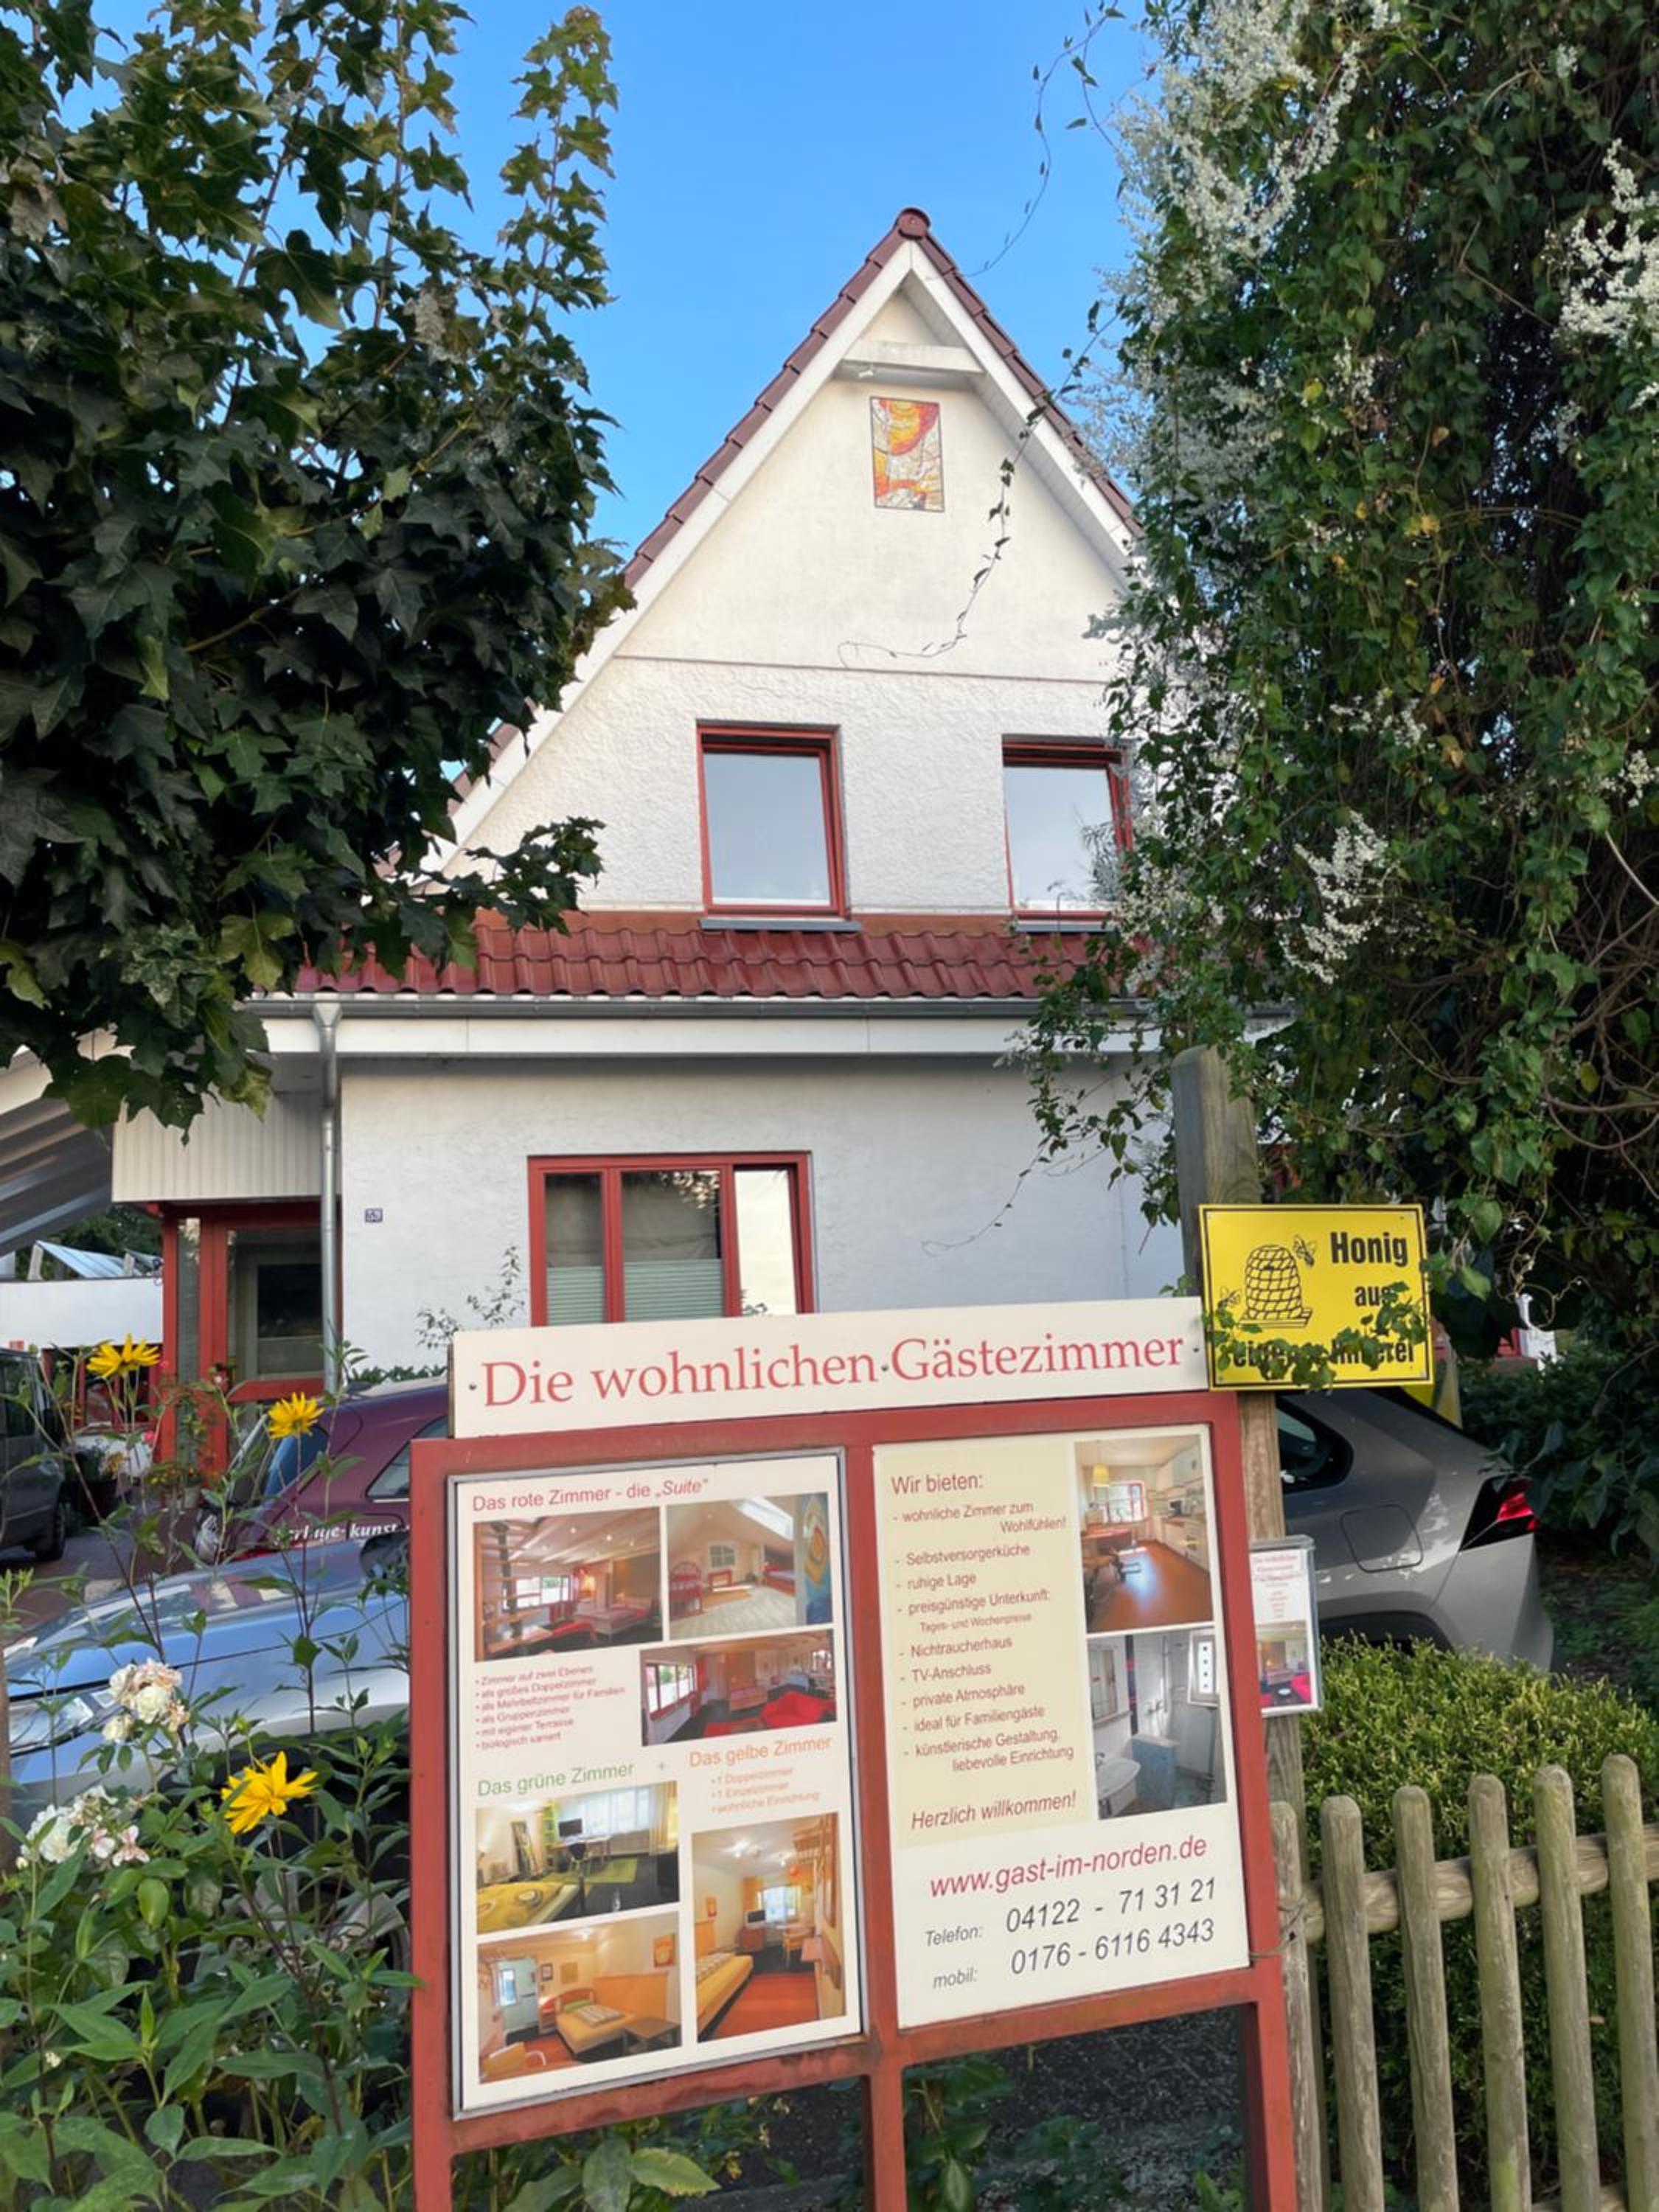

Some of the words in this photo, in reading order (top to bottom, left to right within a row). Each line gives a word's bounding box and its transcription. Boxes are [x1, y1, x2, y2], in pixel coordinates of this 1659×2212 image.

[1330, 1231, 1408, 1267] Honig
[481, 1360, 574, 1408] Die
[591, 1344, 877, 1400] wohnlichen
[891, 1332, 1184, 1382] Gästezimmer
[891, 1475, 921, 1495] Wir
[926, 1473, 984, 1493] bieten:
[472, 1495, 507, 1512] Das
[511, 1491, 544, 1509] rote
[548, 1486, 612, 1506] Zimmer
[626, 1481, 650, 1499] die
[902, 1508, 961, 1523] wohnliche
[964, 1503, 1006, 1519] Zimmer
[1009, 1501, 1034, 1514] zum
[999, 1515, 1067, 1534] Wohlfühlen!
[905, 1543, 1032, 1567] Selbstversorgerküche
[907, 1575, 945, 1592] ruhige
[947, 1572, 977, 1589] Lage
[908, 1597, 987, 1617] preisgünstige
[911, 1636, 1013, 1658] Nichtraucherhaus
[481, 1674, 517, 1686] Zimmer
[531, 1677, 597, 1693] Doppelzimmer
[911, 1663, 992, 1683] TV-Anschluss
[587, 1686, 626, 1699] Familien
[912, 1692, 953, 1709] private
[955, 1683, 1026, 1702] Atmosphäre
[914, 1717, 943, 1733] ideal
[945, 1714, 961, 1728] für
[964, 1705, 1046, 1725] Familiengäste
[689, 1750, 721, 1767] Das
[726, 1744, 769, 1767] gelbe
[773, 1736, 833, 1757] Zimmer
[915, 1736, 992, 1756] künstlerische
[952, 1754, 1007, 1772] liebevolle
[1009, 1745, 1074, 1764] Einrichtung
[478, 1779, 512, 1797] Das
[518, 1773, 566, 1795] grüne
[571, 1762, 636, 1784] Zimmer
[911, 1805, 977, 1830] Herzlich
[981, 1790, 1077, 1821] willkommen!
[930, 1834, 1208, 1899] www.gast-im-norden.de
[1005, 1897, 1081, 1934] 04122
[1119, 1889, 1145, 1915] 71
[1154, 1882, 1180, 1910] 31
[1190, 1877, 1217, 1903] 21
[925, 1924, 984, 1948] Telefon:
[1010, 1941, 1071, 1975] 0176
[1094, 1927, 1151, 1961] 6116
[1158, 1917, 1215, 1950] 4343
[932, 1967, 979, 1990] mobil:
